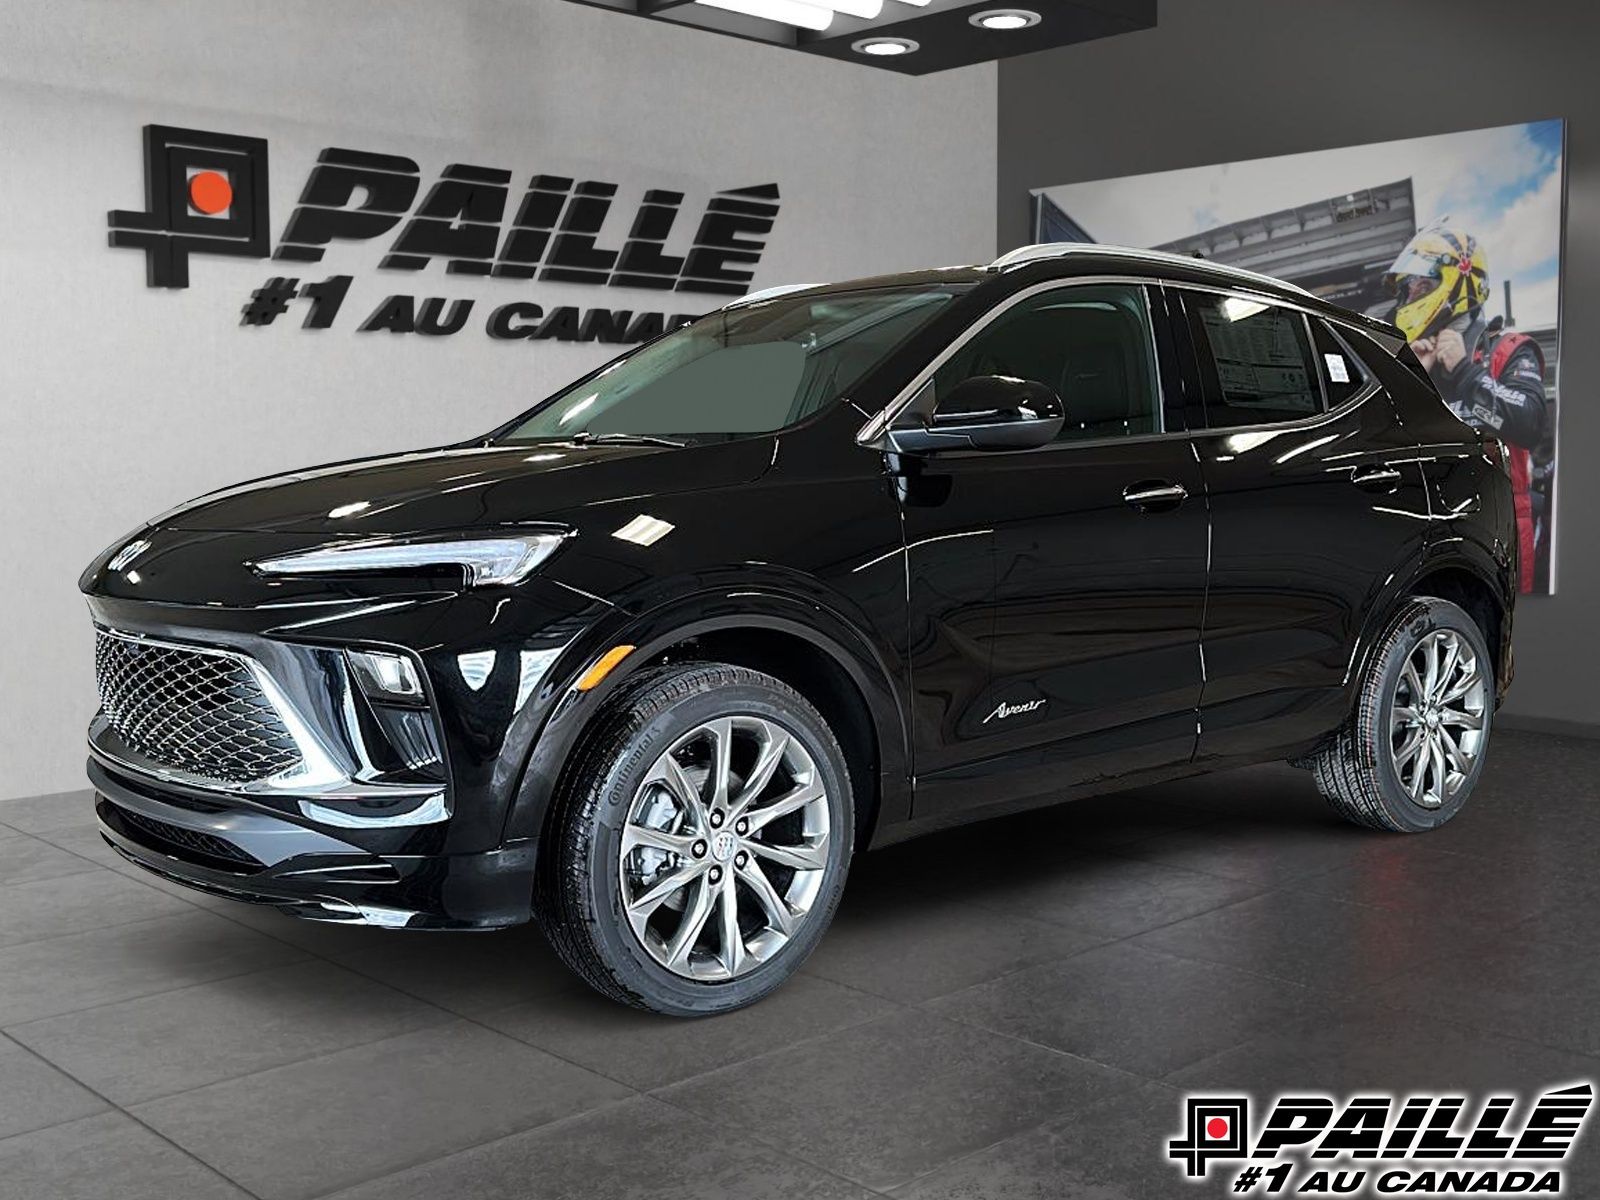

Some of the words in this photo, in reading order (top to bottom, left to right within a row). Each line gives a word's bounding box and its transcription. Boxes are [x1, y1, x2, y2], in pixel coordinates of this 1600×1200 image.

[271, 147, 780, 296] PAILLÉ
[239, 275, 354, 327] #1
[355, 295, 475, 336] AU
[982, 699, 1046, 724] Avenir
